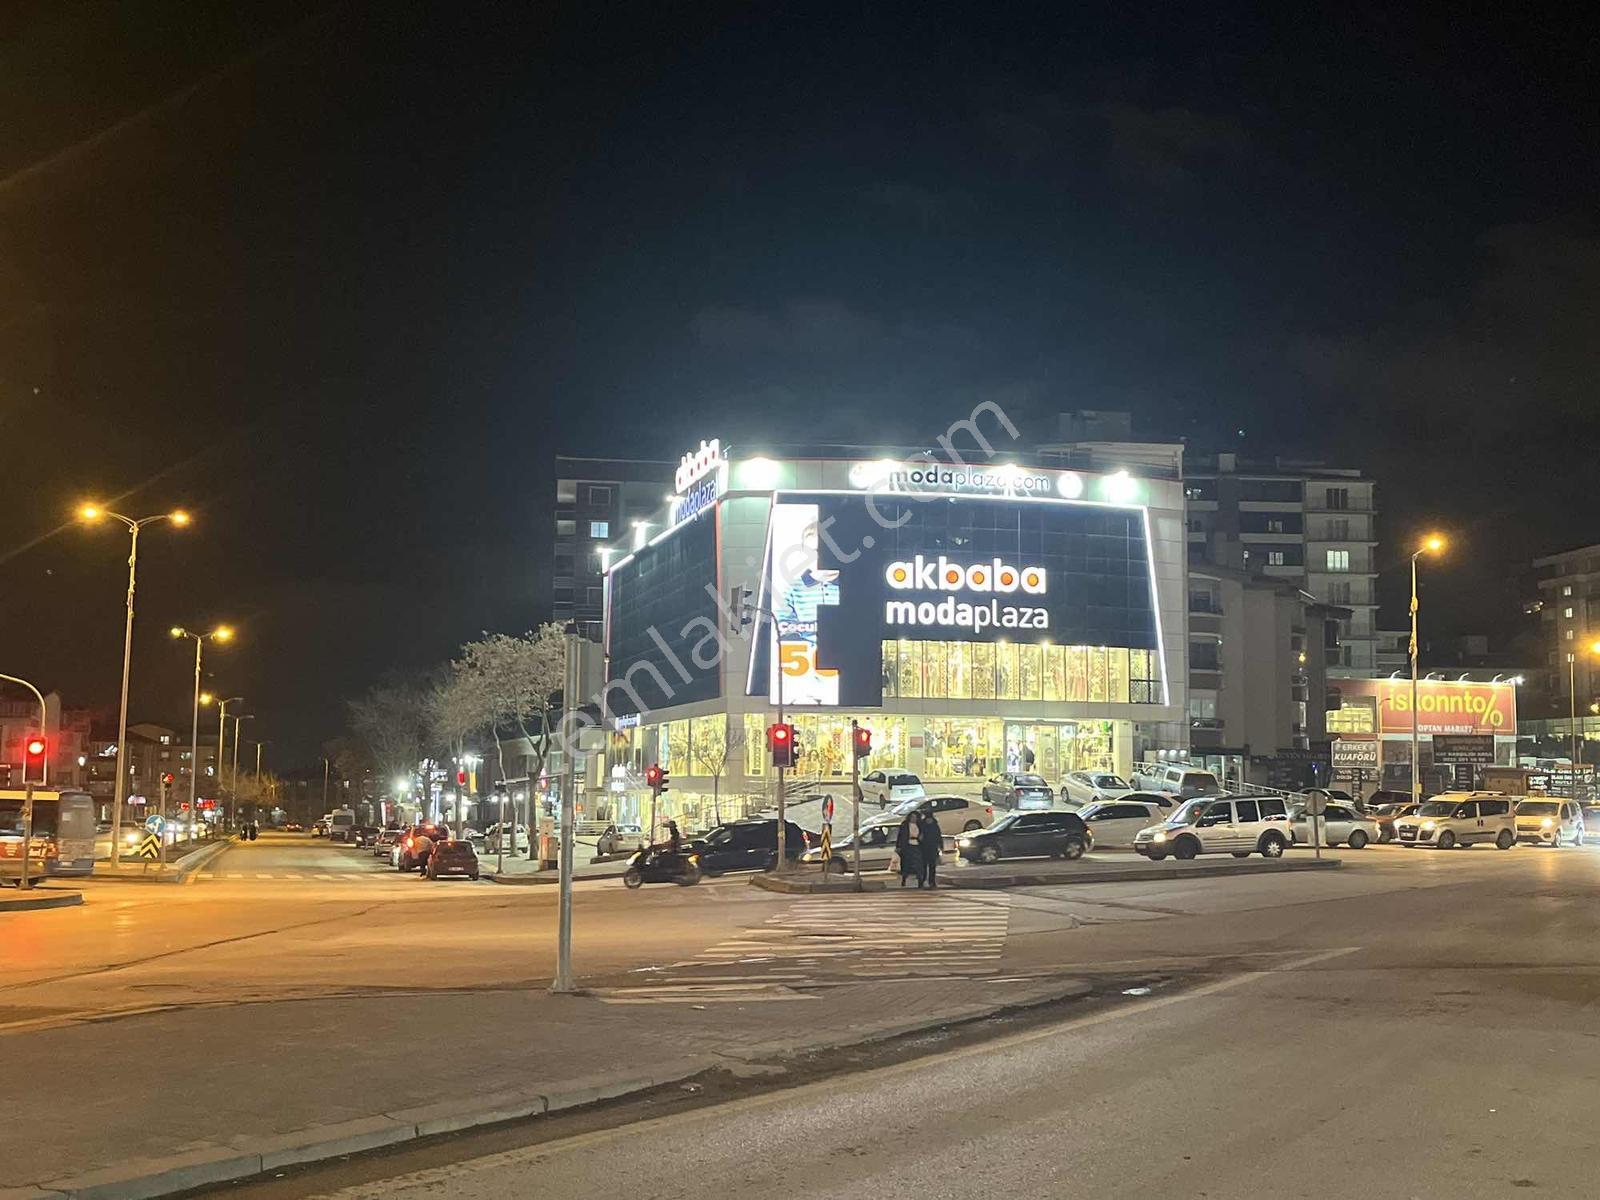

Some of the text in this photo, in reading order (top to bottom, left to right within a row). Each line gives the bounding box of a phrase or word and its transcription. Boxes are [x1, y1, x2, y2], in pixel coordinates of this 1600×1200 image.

[885, 554, 1047, 594] akbaba
[885, 595, 1049, 634] modaplaza
[1334, 751, 1377, 761] KUAFÖRÜ
